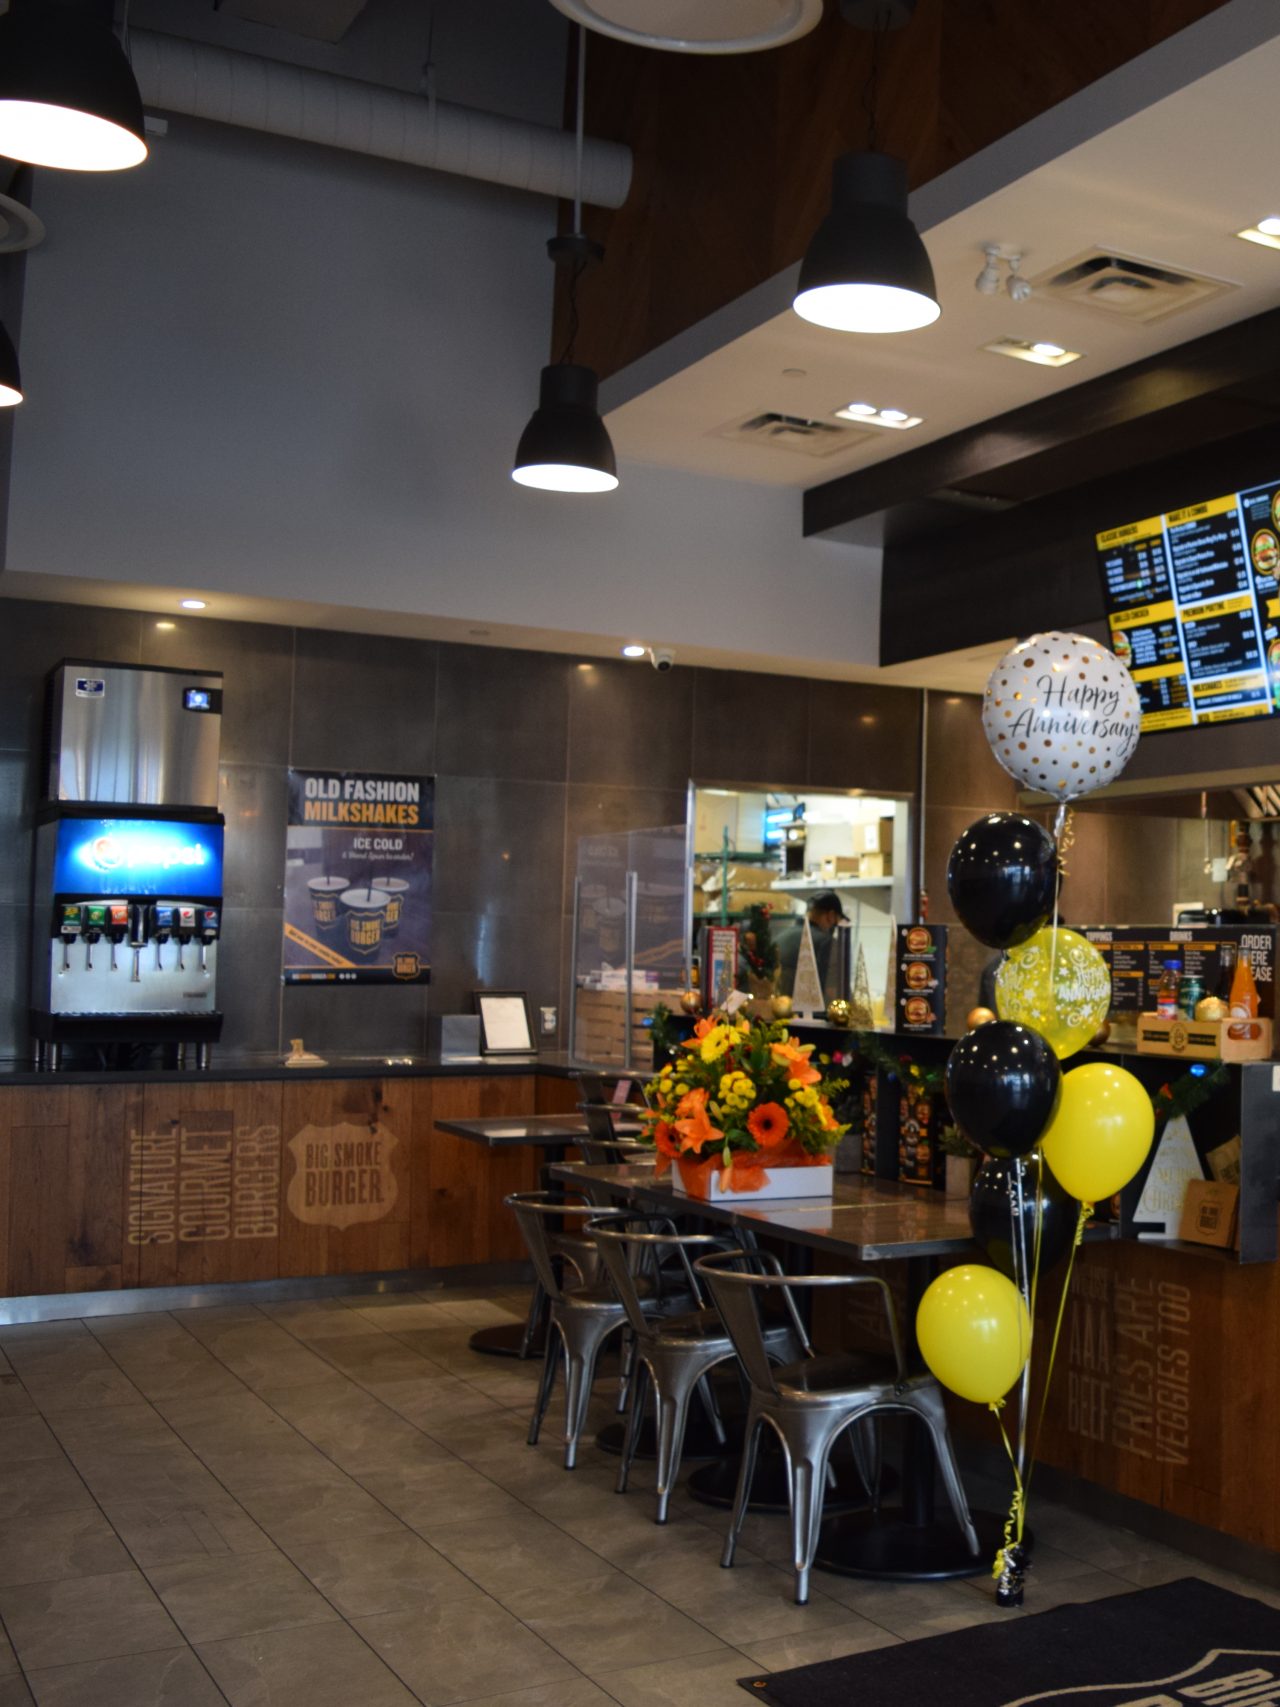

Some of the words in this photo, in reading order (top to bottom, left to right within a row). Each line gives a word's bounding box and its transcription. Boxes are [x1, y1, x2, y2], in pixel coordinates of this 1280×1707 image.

[1036, 674, 1120, 717] Happy
[1008, 707, 1139, 758] Anniversary
[304, 777, 341, 800] OLD
[344, 780, 420, 803] FASHION
[304, 800, 419, 825] MILKSHAKES
[353, 837, 372, 850] ICE
[373, 838, 403, 851] COLD
[1251, 950, 1268, 966] ERE
[305, 1143, 329, 1169] BIG
[334, 1141, 382, 1168] SMOKE
[128, 1128, 178, 1245] SIGNATURE
[179, 1127, 232, 1242] GOURMET
[233, 1124, 280, 1240] BURGERS
[304, 1168, 384, 1207] BURGER
[1157, 1280, 1191, 1336] TOO
[1155, 1344, 1190, 1466] VEGGIES
